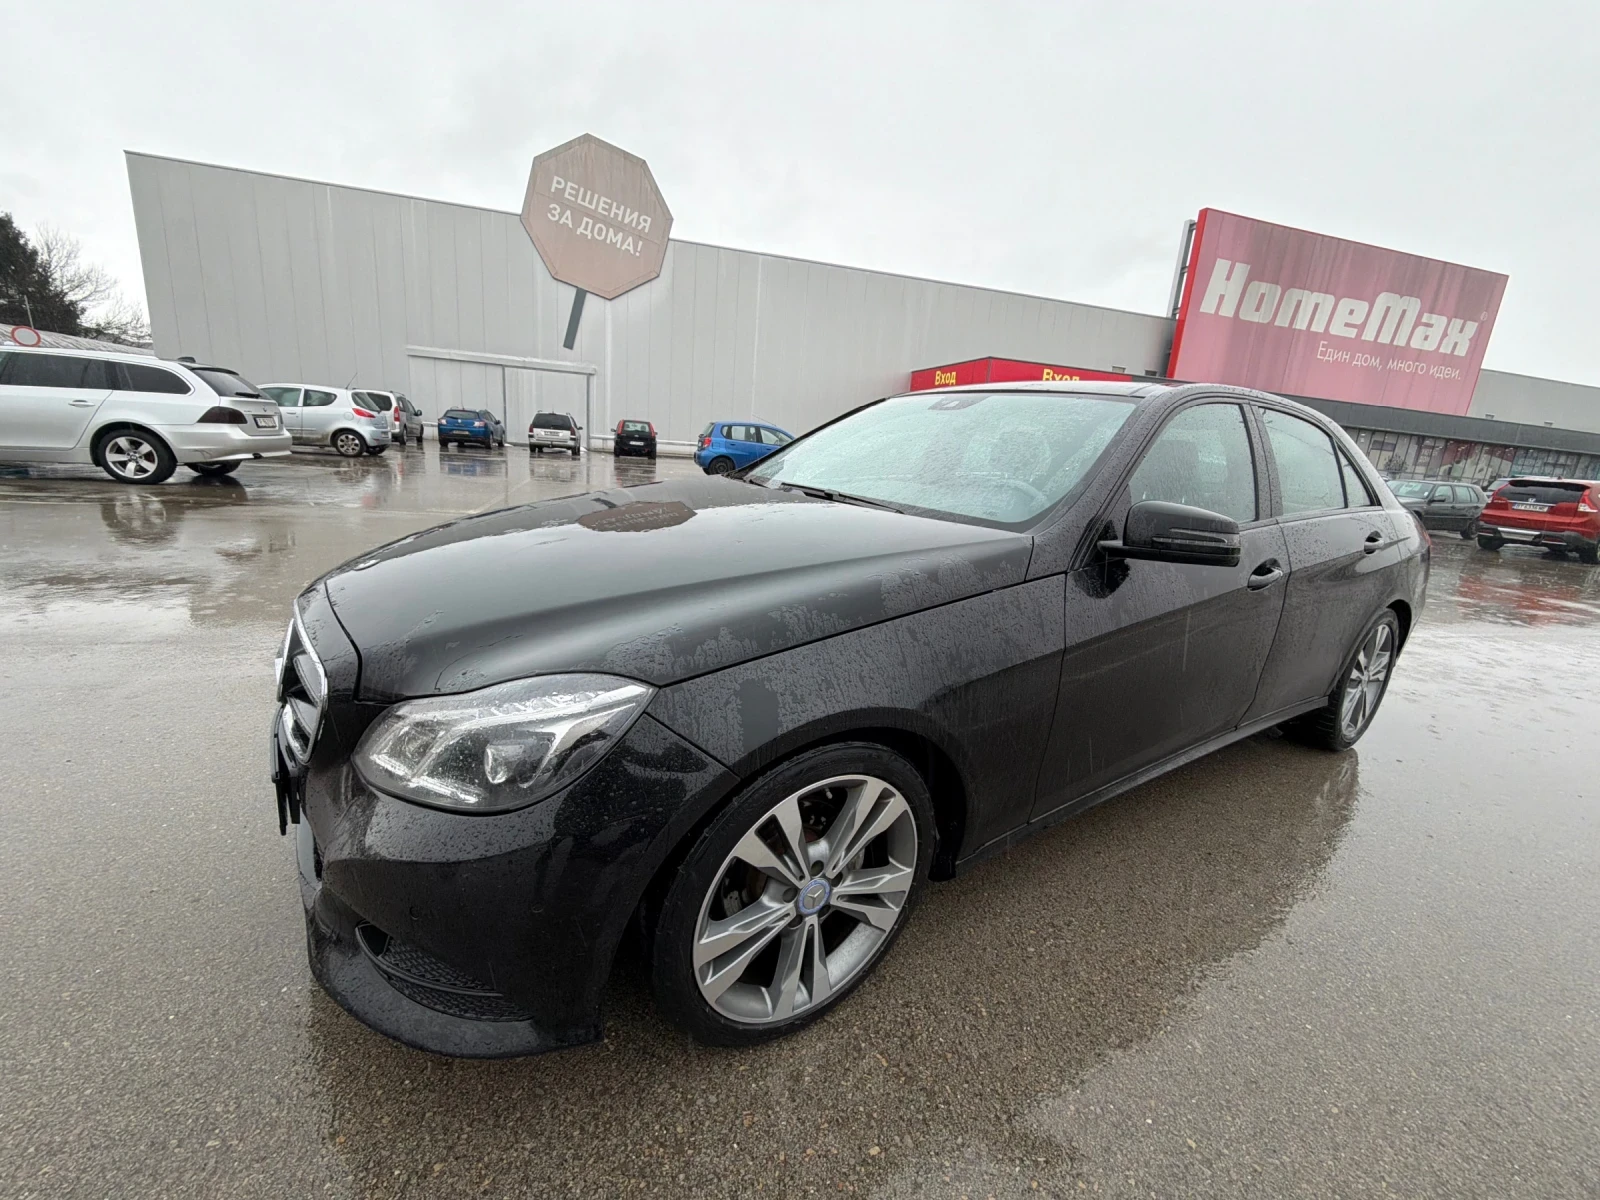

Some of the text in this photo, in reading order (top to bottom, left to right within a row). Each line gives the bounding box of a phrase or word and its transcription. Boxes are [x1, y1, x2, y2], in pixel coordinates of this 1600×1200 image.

[547, 203, 643, 257] ЗА ДОМА!
[550, 176, 652, 233] РЕШЕНИЯ
[1199, 257, 1479, 357] HomeMax
[934, 370, 957, 386] Вход
[1316, 340, 1461, 381] Един дом, много идеи.
